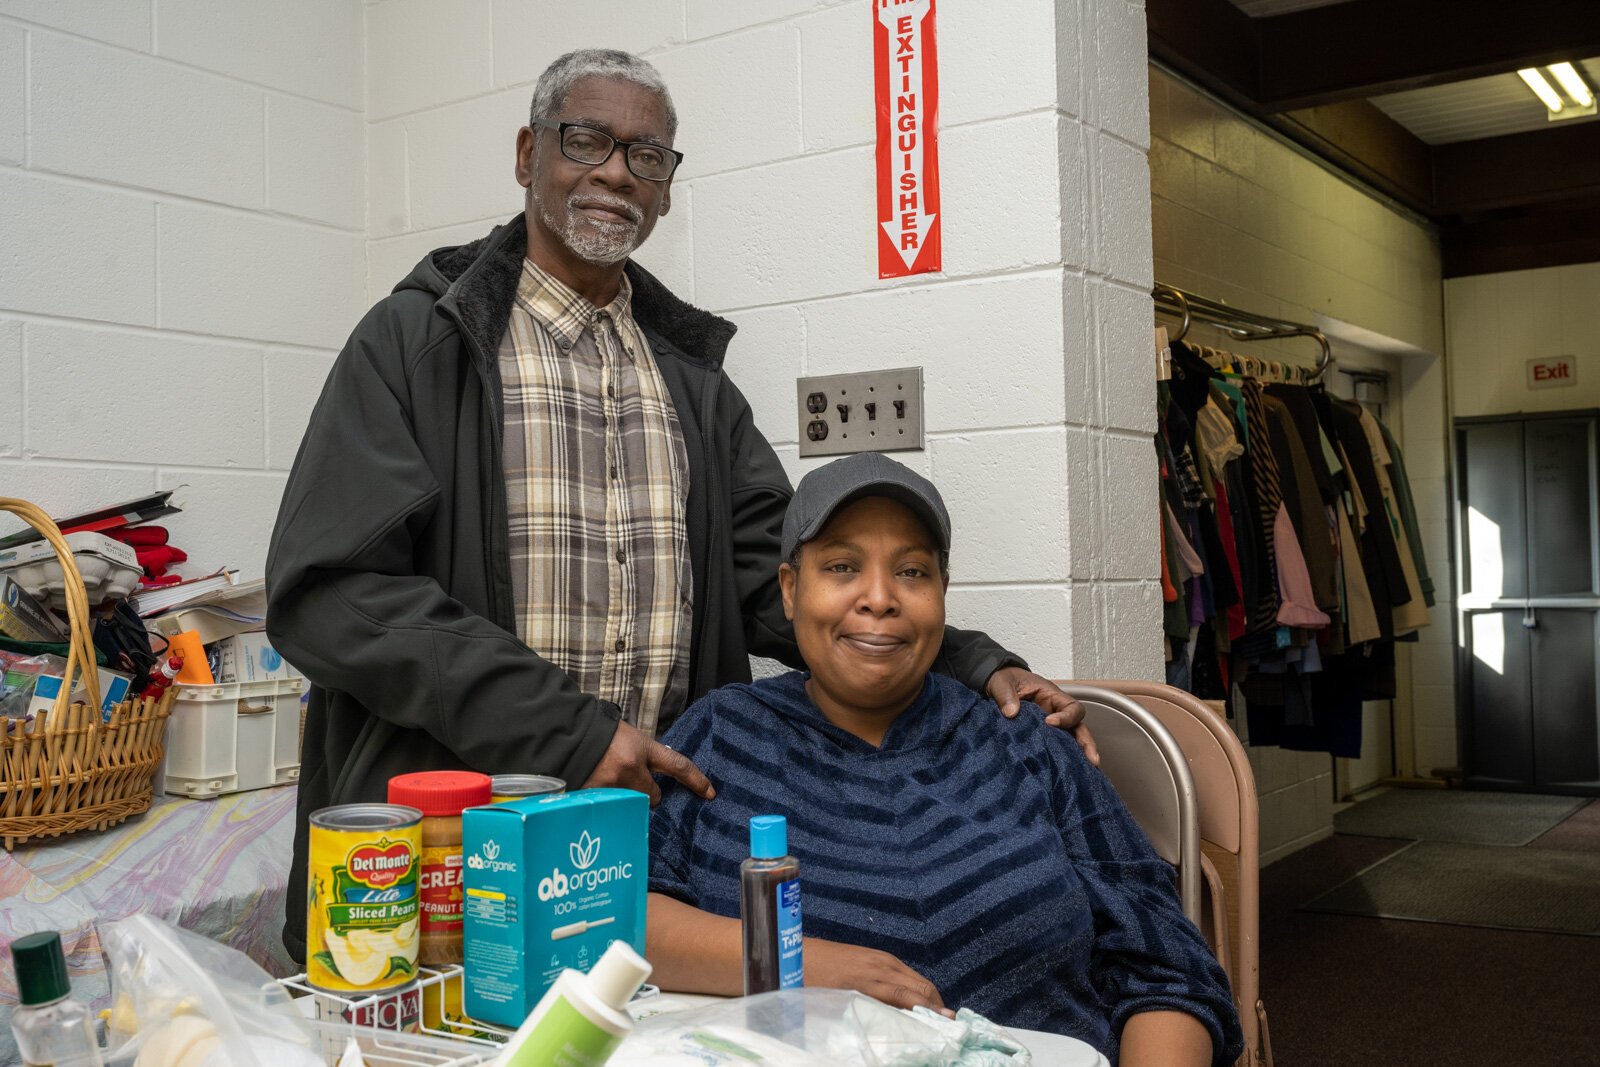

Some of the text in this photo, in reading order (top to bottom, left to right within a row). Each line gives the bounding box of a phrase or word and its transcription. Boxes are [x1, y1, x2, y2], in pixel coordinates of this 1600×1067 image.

[896, 15, 919, 251] EXTINGUISHER
[1533, 362, 1570, 381] Exit
[353, 853, 410, 871] Del Monte
[370, 872, 396, 881] Quality
[569, 860, 632, 892] organic
[361, 888, 401, 903] Lite
[348, 902, 416, 919] Sliced Pears
[419, 901, 457, 914] PEANUT
[553, 900, 577, 916] 100%
